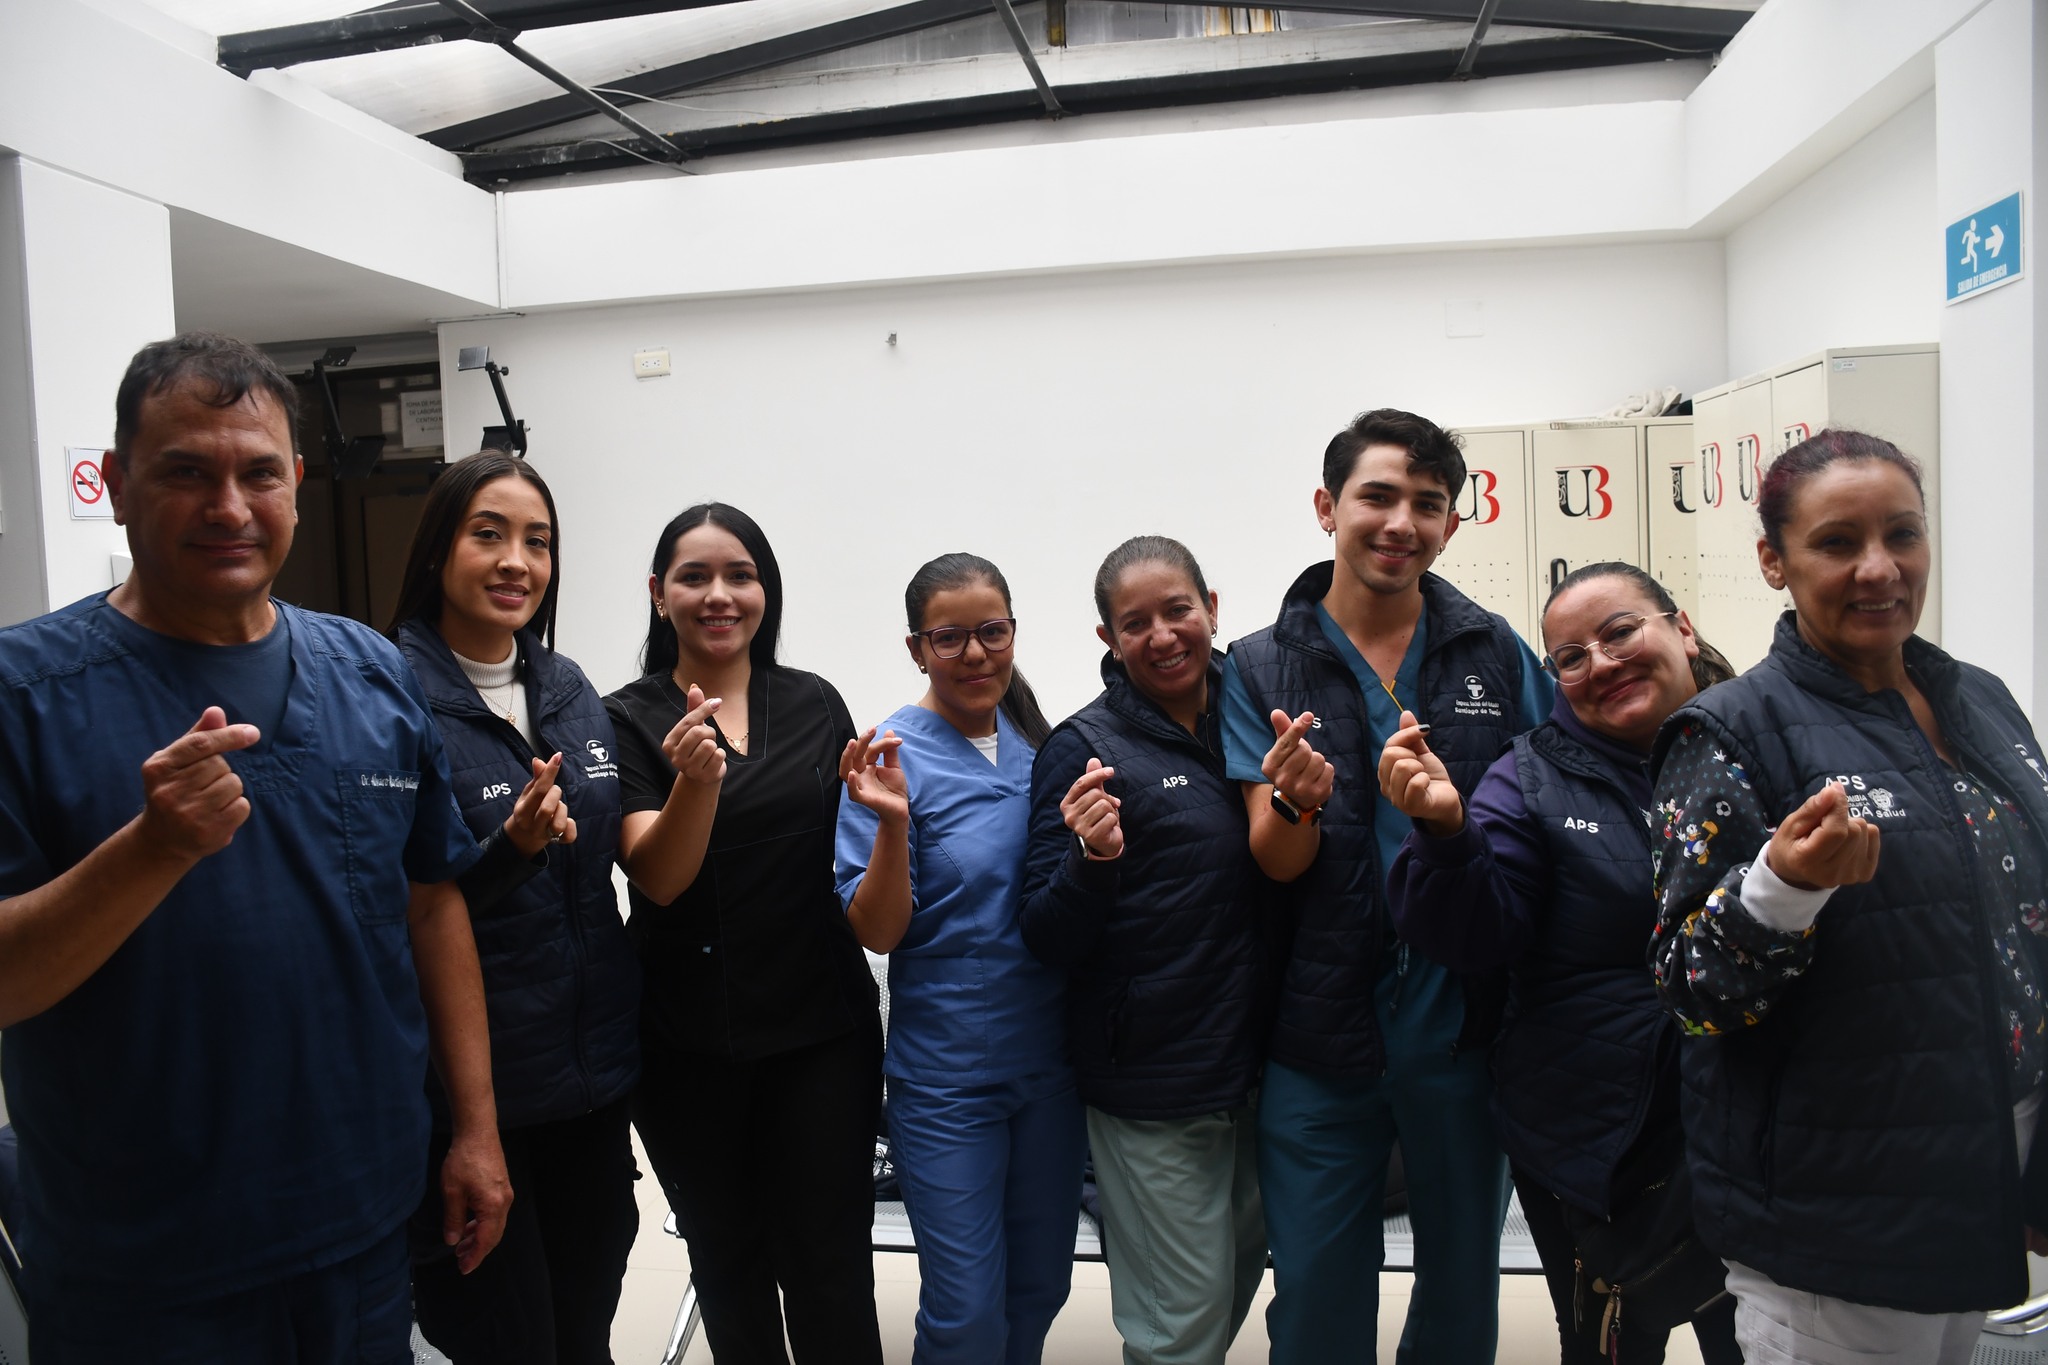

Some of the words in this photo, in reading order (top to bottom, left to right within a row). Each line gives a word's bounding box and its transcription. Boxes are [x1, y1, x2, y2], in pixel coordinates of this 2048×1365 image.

[1957, 277, 1973, 294] SALIDA
[1455, 706, 1479, 715] Santiago
[1162, 775, 1188, 789] APS
[482, 782, 512, 800] APS
[1875, 808, 1906, 819] Salud
[1564, 816, 1599, 834] APS
